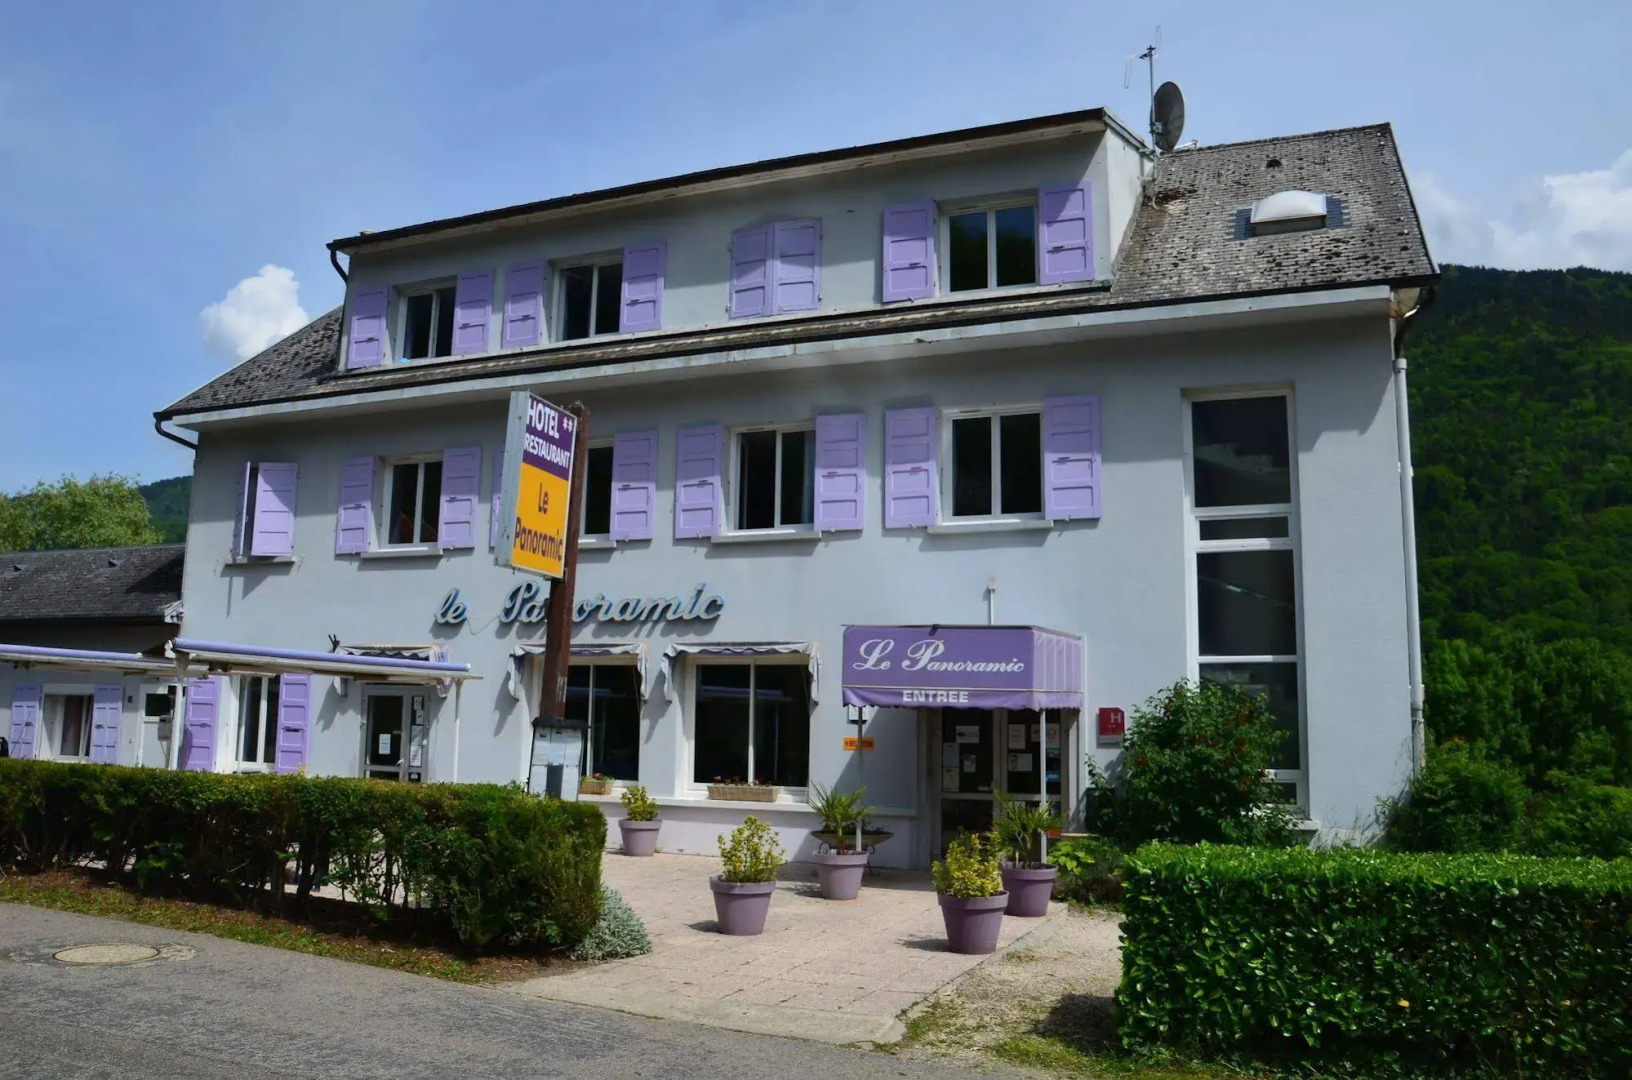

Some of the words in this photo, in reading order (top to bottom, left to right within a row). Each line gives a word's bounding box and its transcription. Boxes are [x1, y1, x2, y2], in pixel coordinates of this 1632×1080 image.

[526, 398, 560, 439] HOTEL
[523, 432, 571, 469] RESTAURANT
[538, 482, 549, 515] Le
[513, 516, 563, 562] Panoramic
[433, 587, 468, 625] le
[500, 580, 725, 624] Paoramic
[853, 638, 894, 670] Le
[901, 639, 1025, 673] Panoramic
[902, 690, 969, 704] ENTREE
[1110, 712, 1122, 724] H
